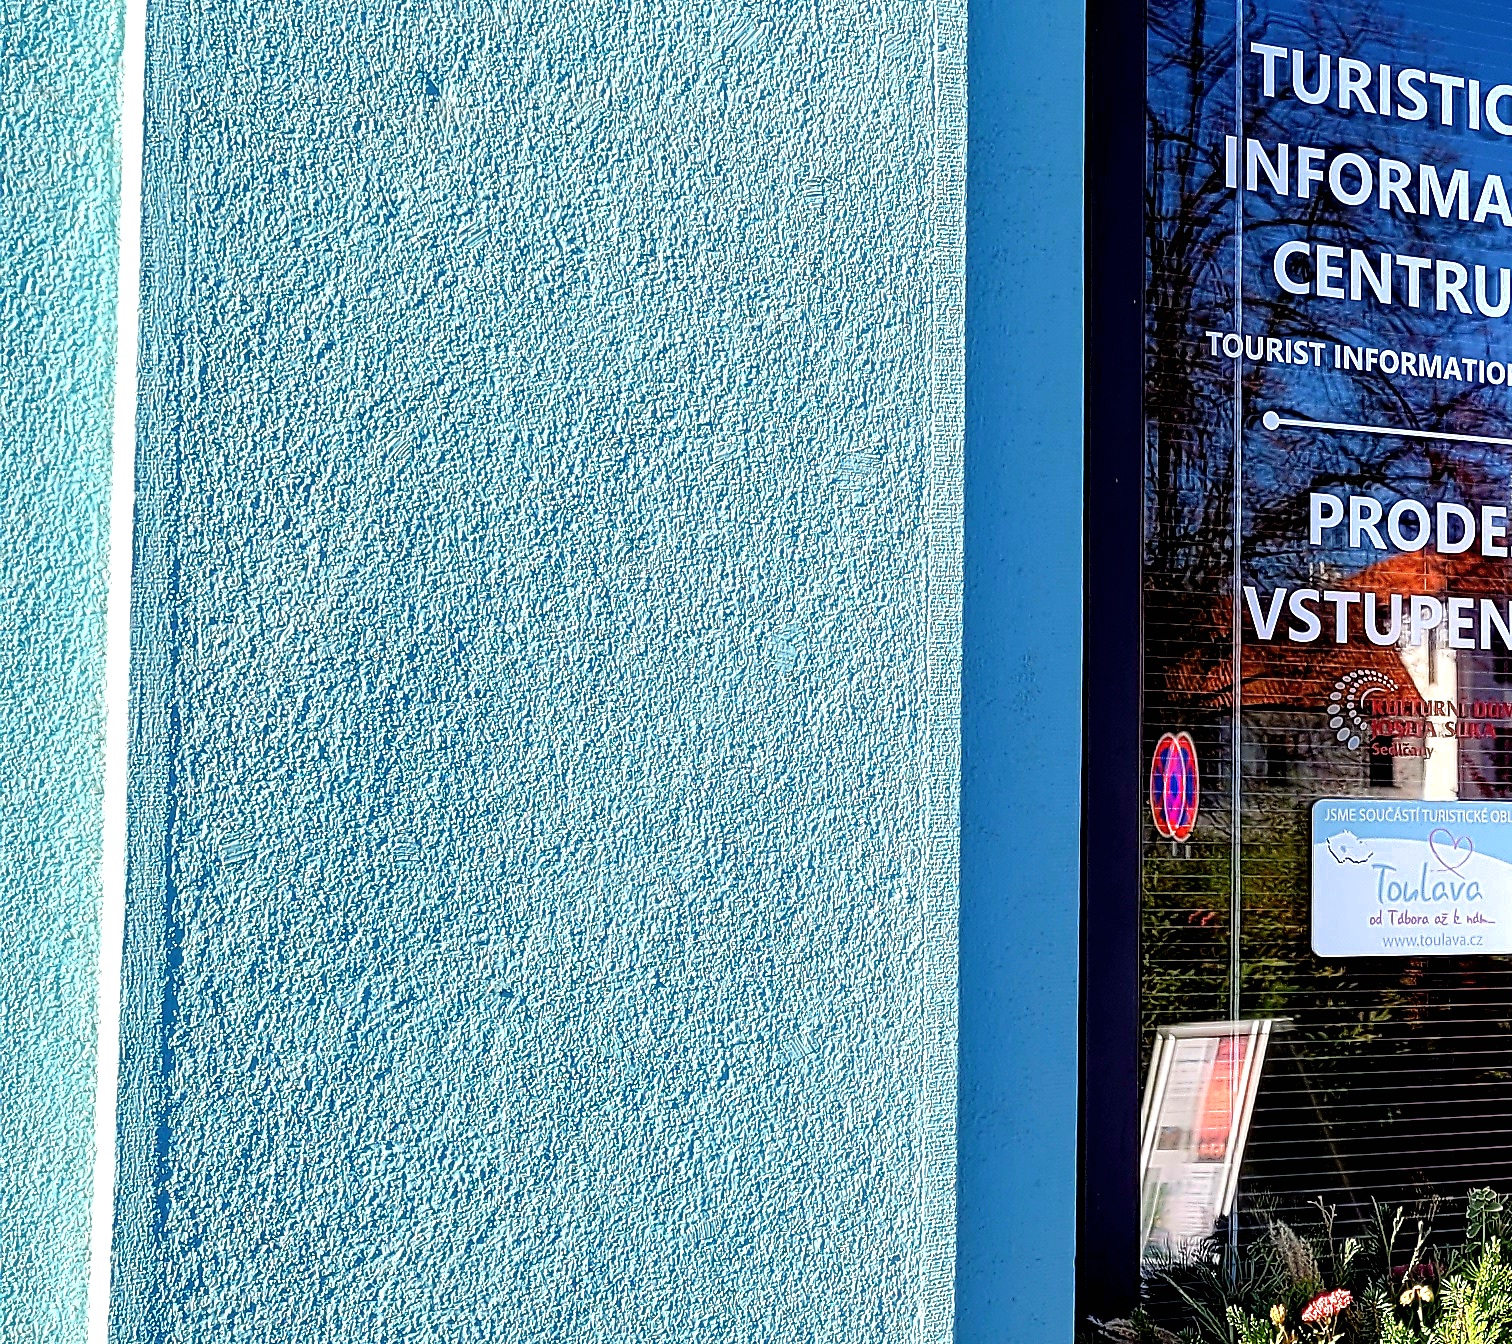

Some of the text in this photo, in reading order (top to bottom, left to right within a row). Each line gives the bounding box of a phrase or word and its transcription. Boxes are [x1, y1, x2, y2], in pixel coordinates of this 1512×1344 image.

[1205, 331, 1326, 367] TOURIST
[1371, 742, 1434, 761] Sedlčany
[1324, 807, 1357, 823] JSME
[1358, 806, 1420, 823] SOUČÁSTÍ
[1421, 806, 1488, 824] TURISTICKÉ
[1371, 861, 1483, 905] Toulava
[1369, 909, 1383, 926] od
[1387, 909, 1430, 926] Tábora
[1434, 913, 1449, 927] až
[1382, 932, 1484, 948] www.toulava.cz
